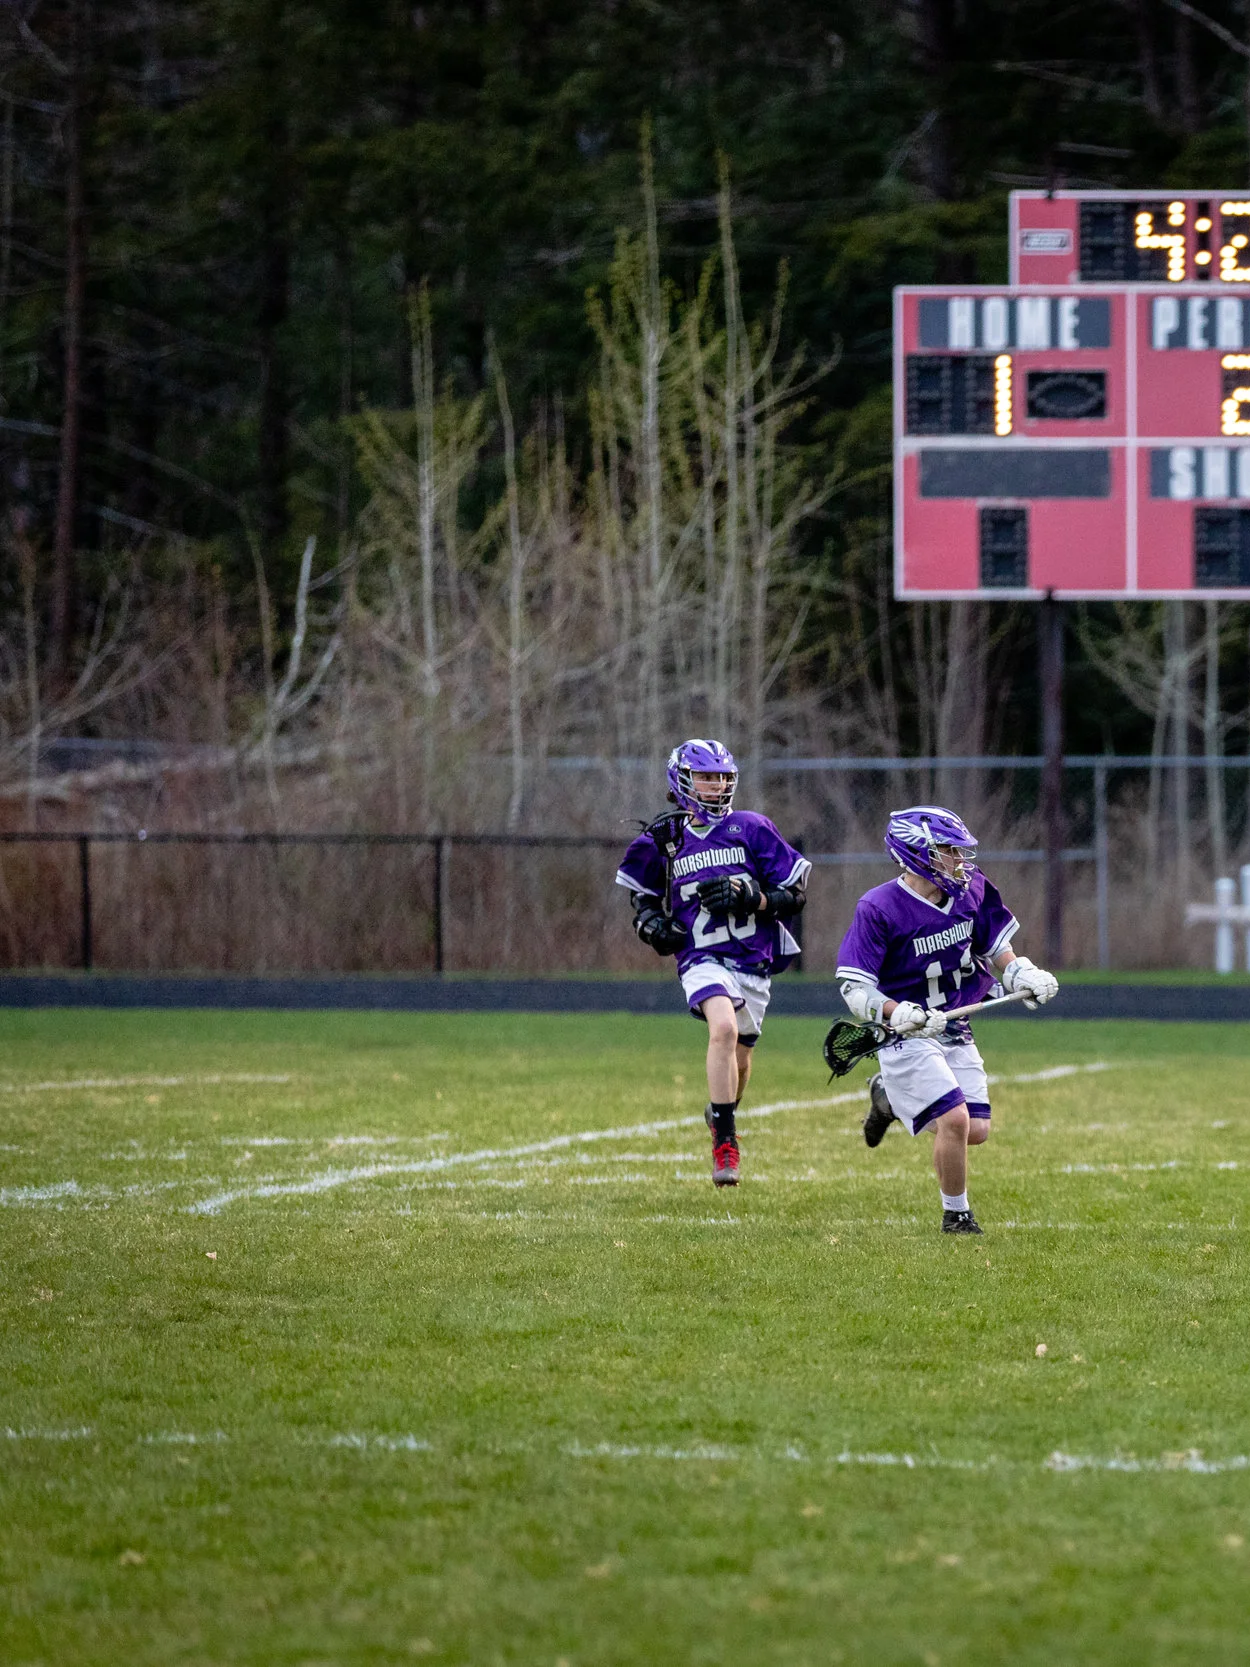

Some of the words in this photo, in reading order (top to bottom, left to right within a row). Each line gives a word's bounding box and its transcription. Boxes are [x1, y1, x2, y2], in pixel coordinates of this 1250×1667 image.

[948, 296, 1080, 350] HOME
[994, 354, 1013, 436] 1
[673, 846, 747, 879] MARSHWOOD
